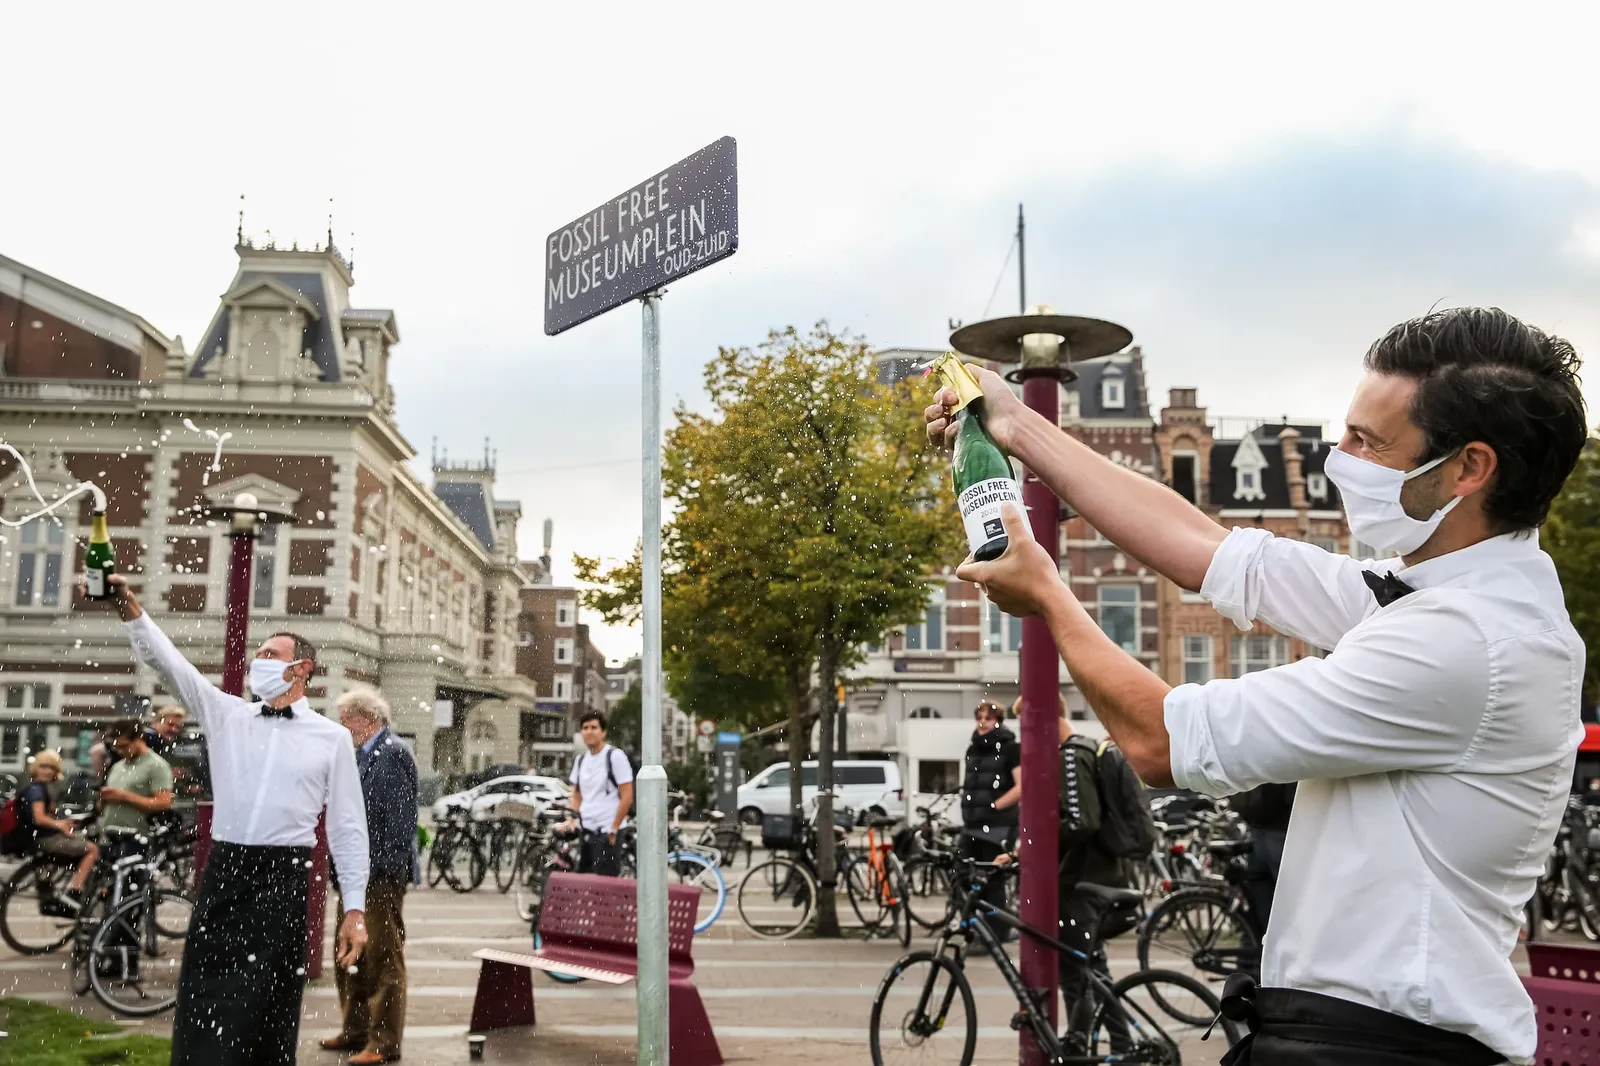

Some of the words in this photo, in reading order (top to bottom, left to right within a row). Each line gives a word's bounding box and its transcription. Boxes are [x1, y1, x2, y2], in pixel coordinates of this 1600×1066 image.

[549, 209, 610, 270] FOSSIL
[618, 173, 670, 233] FREE
[549, 199, 706, 310] MUSEUMPLEIN
[664, 230, 727, 275] OUD-ZUID
[962, 485, 987, 505] FOSSIL
[987, 481, 1009, 491] FREE
[962, 492, 1017, 518] MUSEUMPLEIN
[980, 507, 998, 518] 2020
